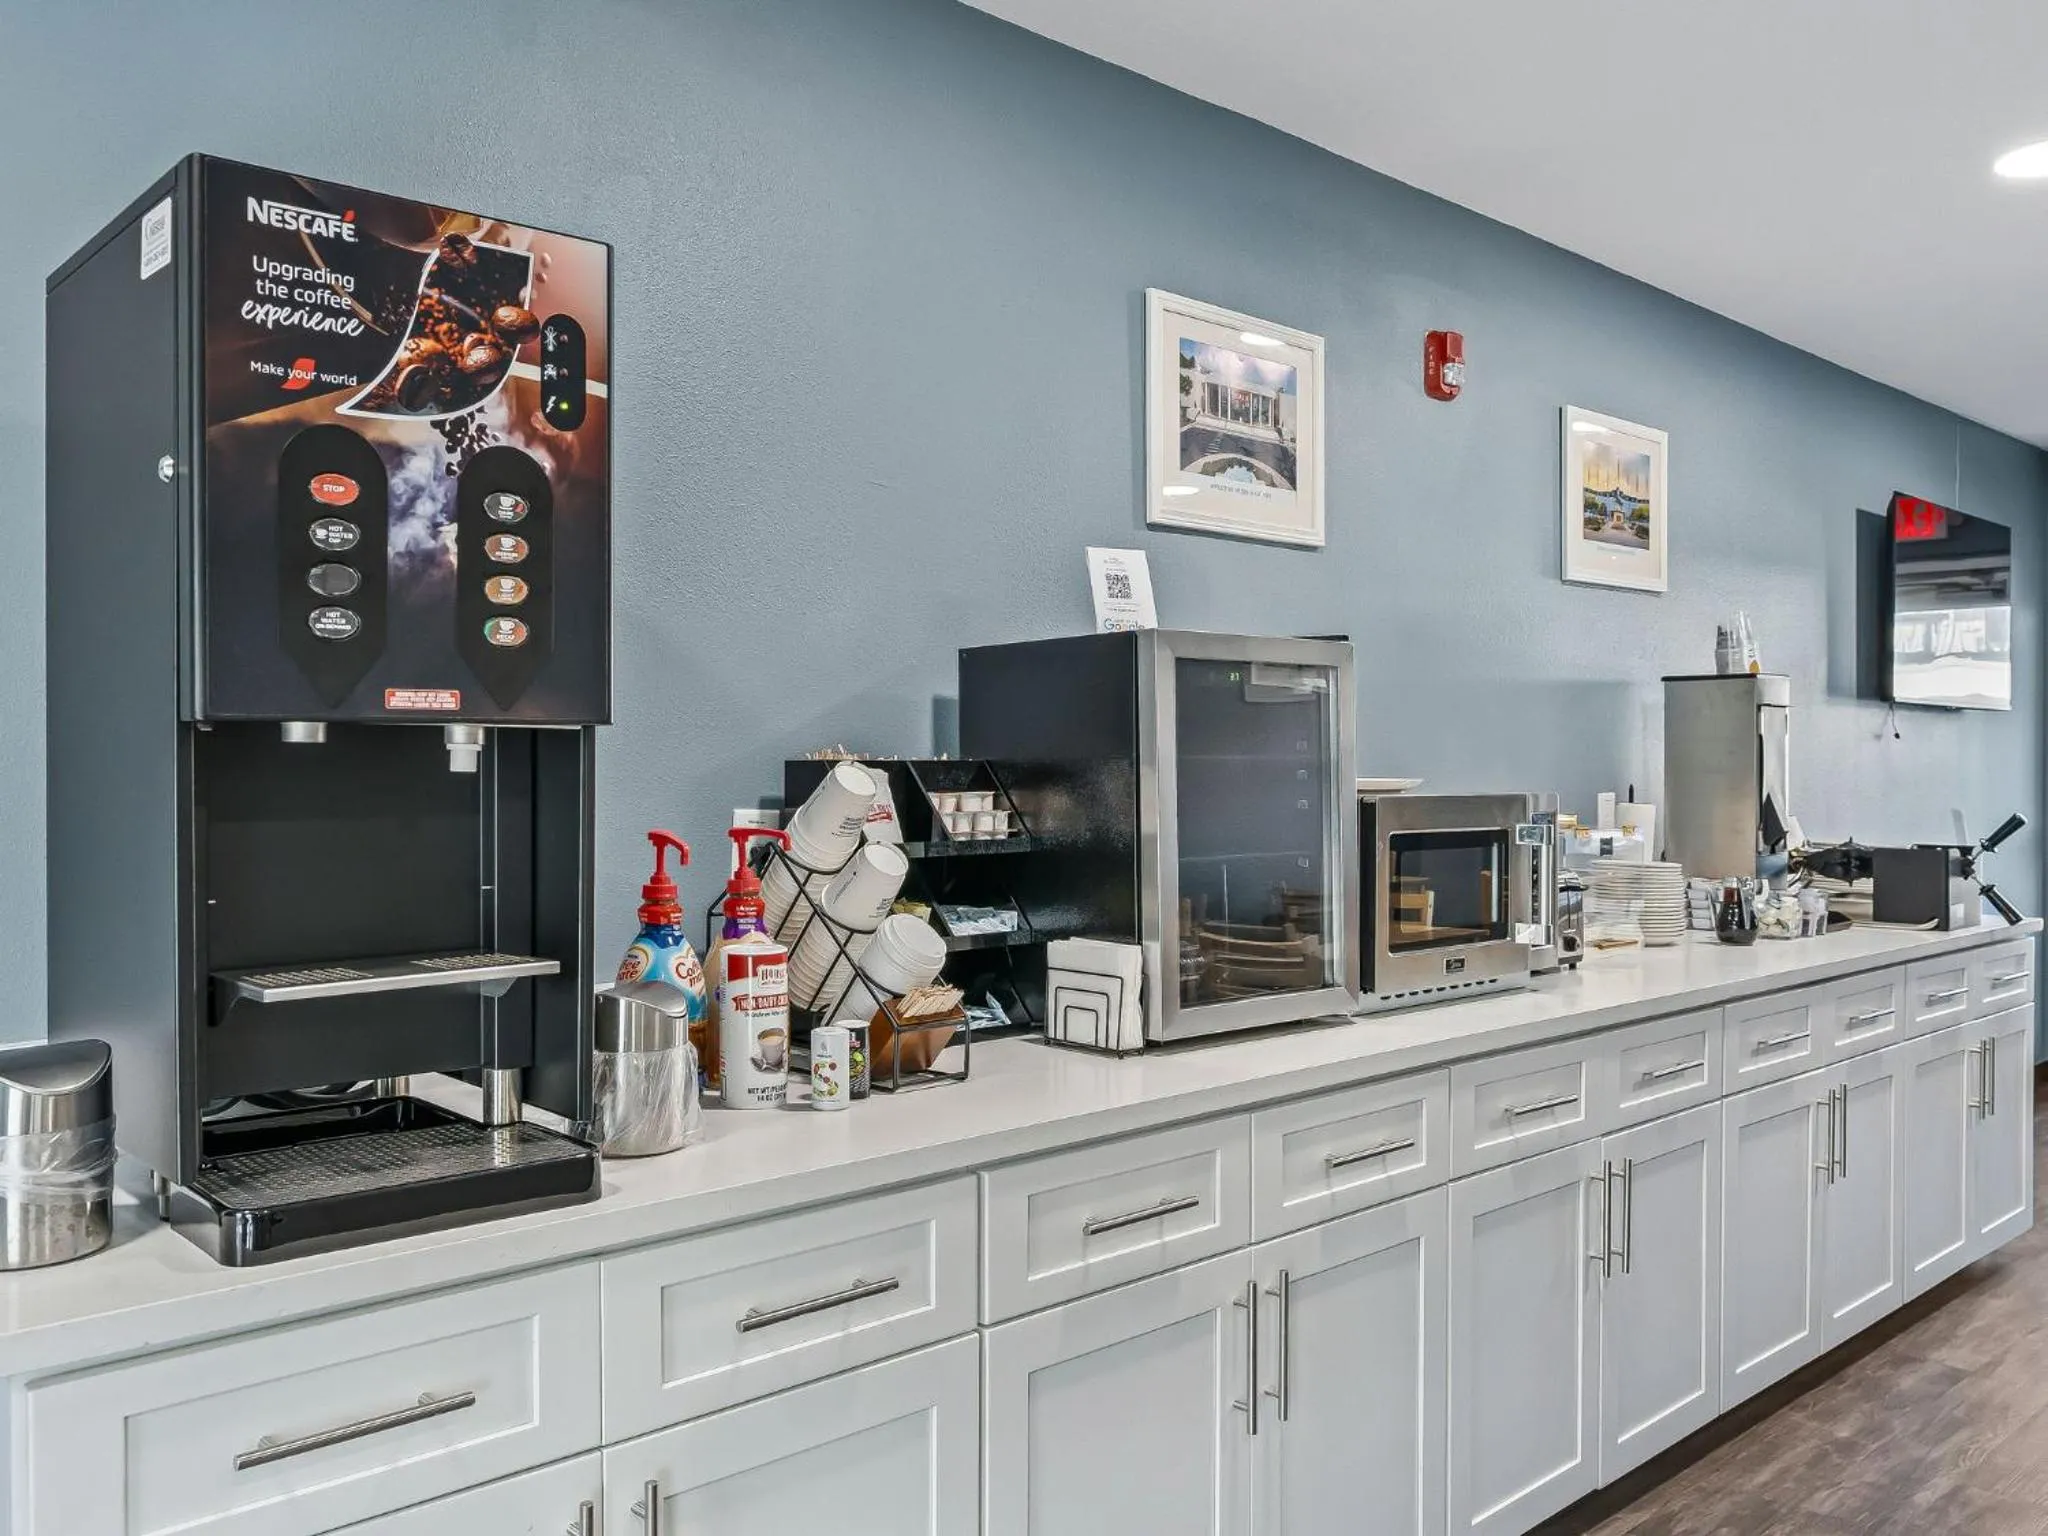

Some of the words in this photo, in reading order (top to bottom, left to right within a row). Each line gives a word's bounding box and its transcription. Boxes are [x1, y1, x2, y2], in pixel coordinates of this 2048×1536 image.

[246, 196, 357, 242] NESCAFÉ
[252, 254, 355, 292] Upgrading
[256, 278, 289, 299] the
[293, 288, 352, 310] coffee
[240, 299, 365, 336] experience
[250, 361, 285, 376] Make
[288, 367, 317, 380] your
[320, 373, 358, 386] world
[322, 484, 346, 493] STOP
[328, 531, 354, 539] WATER
[320, 617, 346, 625] WATER
